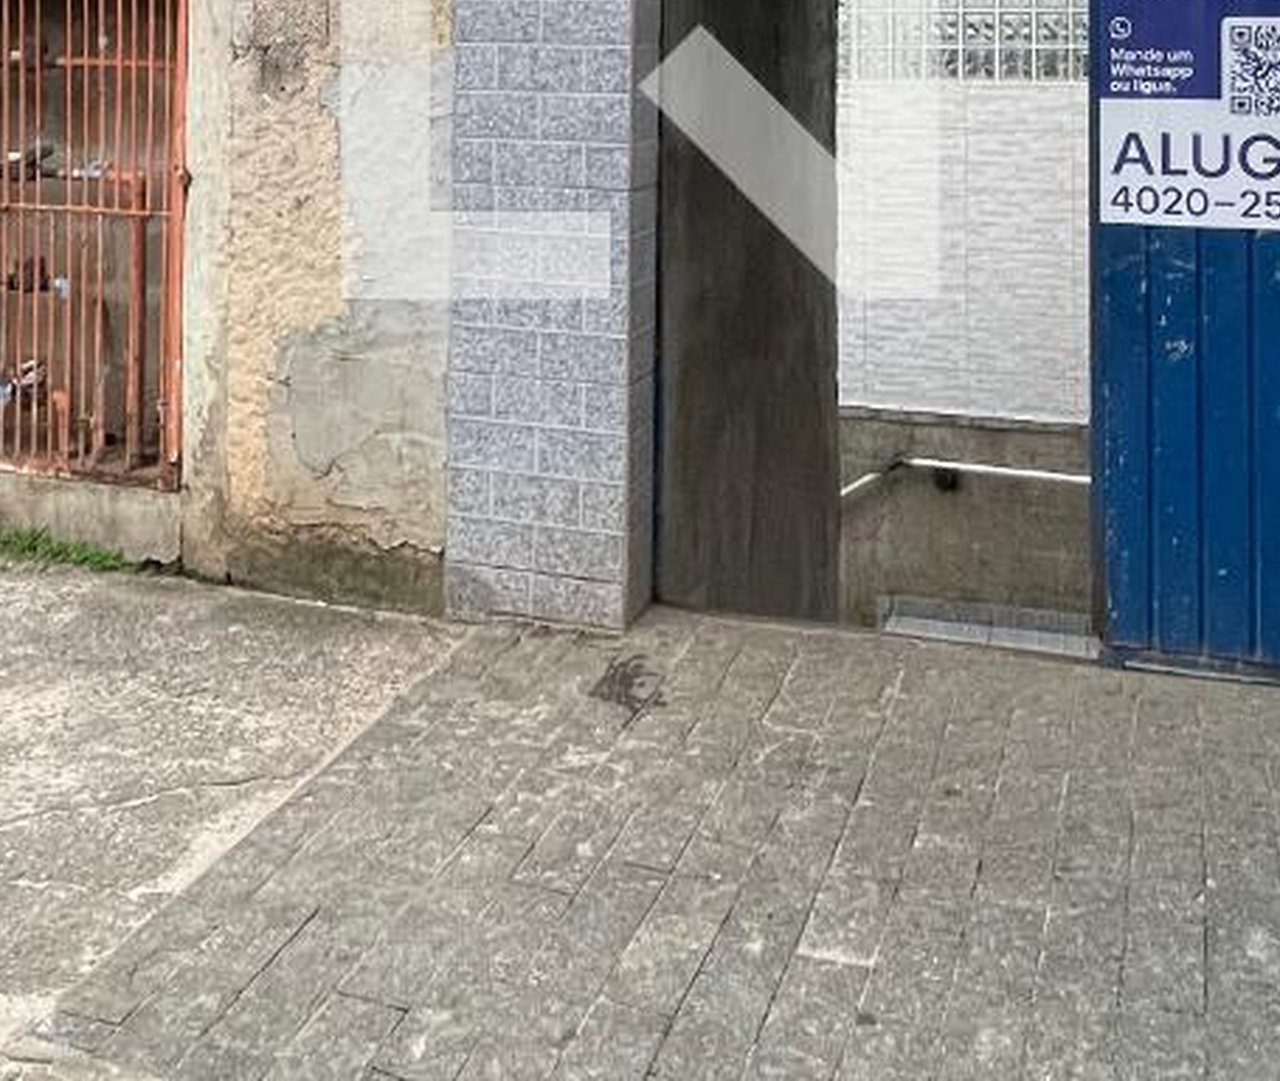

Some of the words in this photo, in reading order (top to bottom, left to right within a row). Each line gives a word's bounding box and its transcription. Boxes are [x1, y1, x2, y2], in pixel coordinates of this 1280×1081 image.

[1110, 48, 1164, 62] Mande
[1167, 50, 1194, 62] um
[1110, 63, 1194, 80] Whatsapp
[1110, 81, 1131, 92] ou
